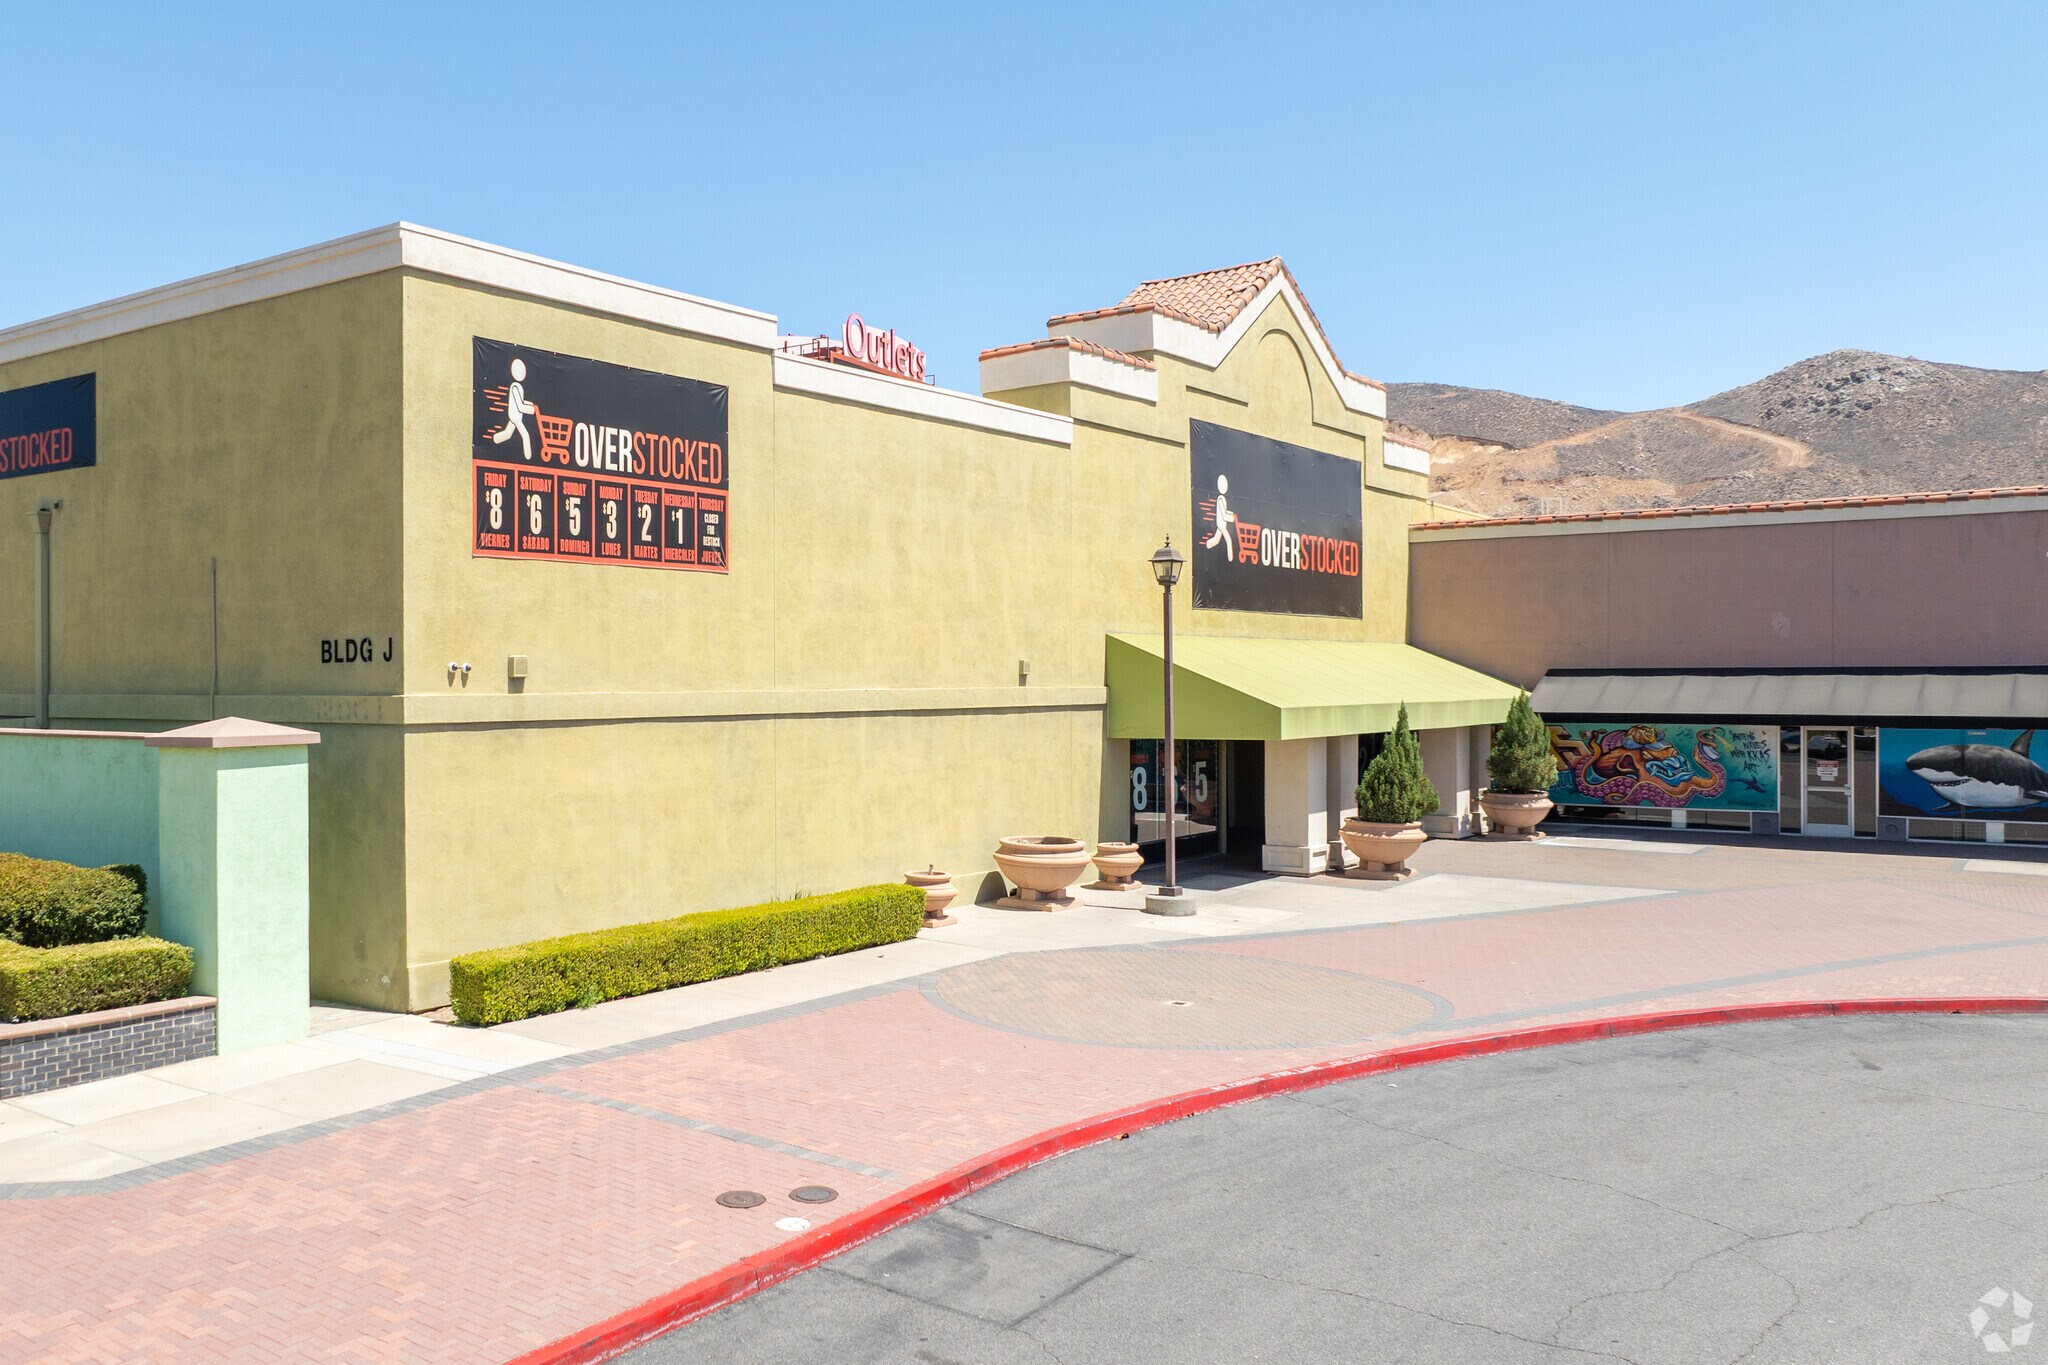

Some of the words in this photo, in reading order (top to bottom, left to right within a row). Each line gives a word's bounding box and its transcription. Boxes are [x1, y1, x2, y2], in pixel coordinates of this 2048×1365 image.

[846, 312, 926, 379] Outlets
[0, 427, 73, 472] STOCKED
[574, 422, 722, 484] OVERSTOCKED
[484, 472, 507, 488] FRIDAY
[520, 476, 552, 493] SATURDAY
[562, 481, 587, 497] SUNDAY
[599, 486, 624, 501] MONDAY
[634, 489, 659, 505] TUESDAY
[485, 488, 503, 530] $8
[664, 493, 695, 509] WEDNESDAY
[698, 497, 724, 512] THURSDAY
[526, 494, 543, 535] $6
[565, 497, 581, 536] $5
[602, 500, 618, 539] $3
[637, 504, 652, 542] $2
[704, 513, 719, 524] CLOSED
[671, 508, 684, 545] $1
[706, 525, 715, 535] FOR
[480, 532, 510, 549] VIERNES
[522, 533, 550, 551] SÁBADO
[560, 538, 590, 554] DOMINGO
[702, 535, 721, 548] RESTOCK
[601, 542, 622, 557] LUNES
[634, 544, 659, 560] MARTES
[1261, 527, 1359, 577] OVERSTOCKED
[321, 637, 372, 664] BLDG
[382, 637, 393, 662] J
